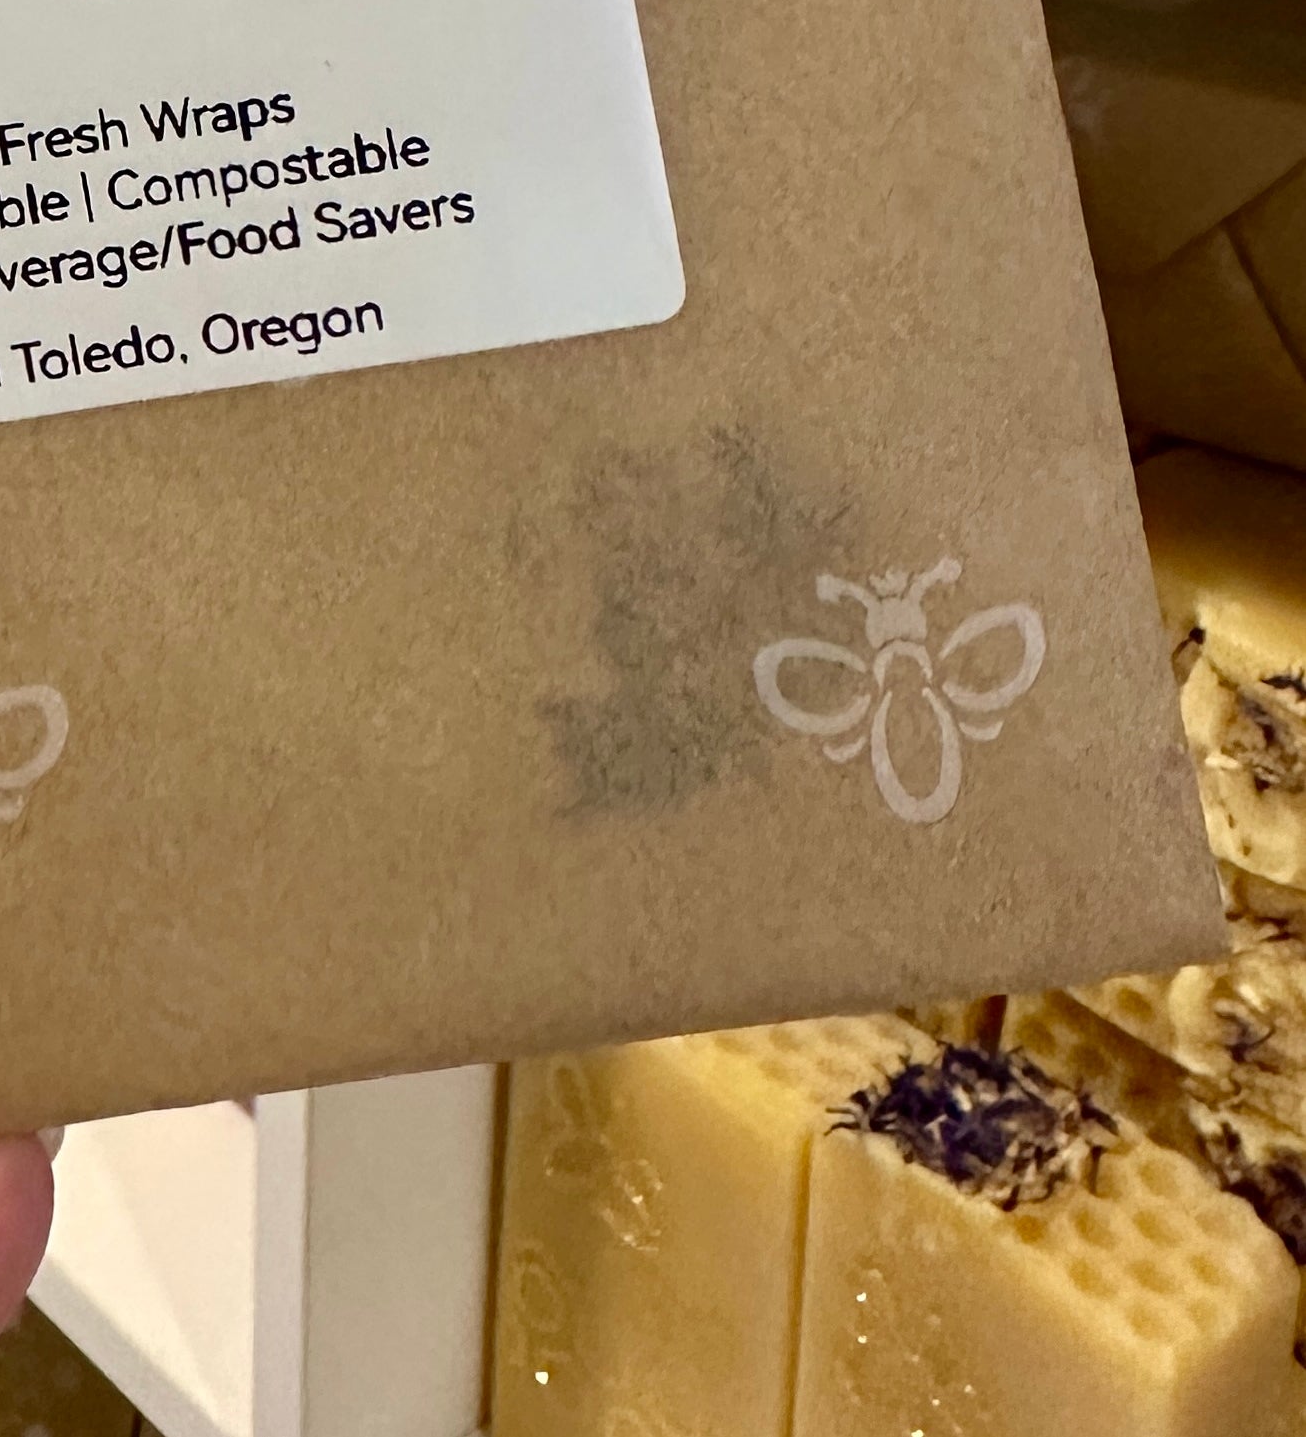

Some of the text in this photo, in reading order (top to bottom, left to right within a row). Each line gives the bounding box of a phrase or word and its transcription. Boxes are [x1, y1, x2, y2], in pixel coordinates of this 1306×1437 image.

[140, 93, 296, 143] Wraps
[107, 127, 431, 211] Compostable
[314, 192, 475, 244] Savers
[10, 325, 189, 384] Toledo,
[202, 301, 384, 356] Oregon
